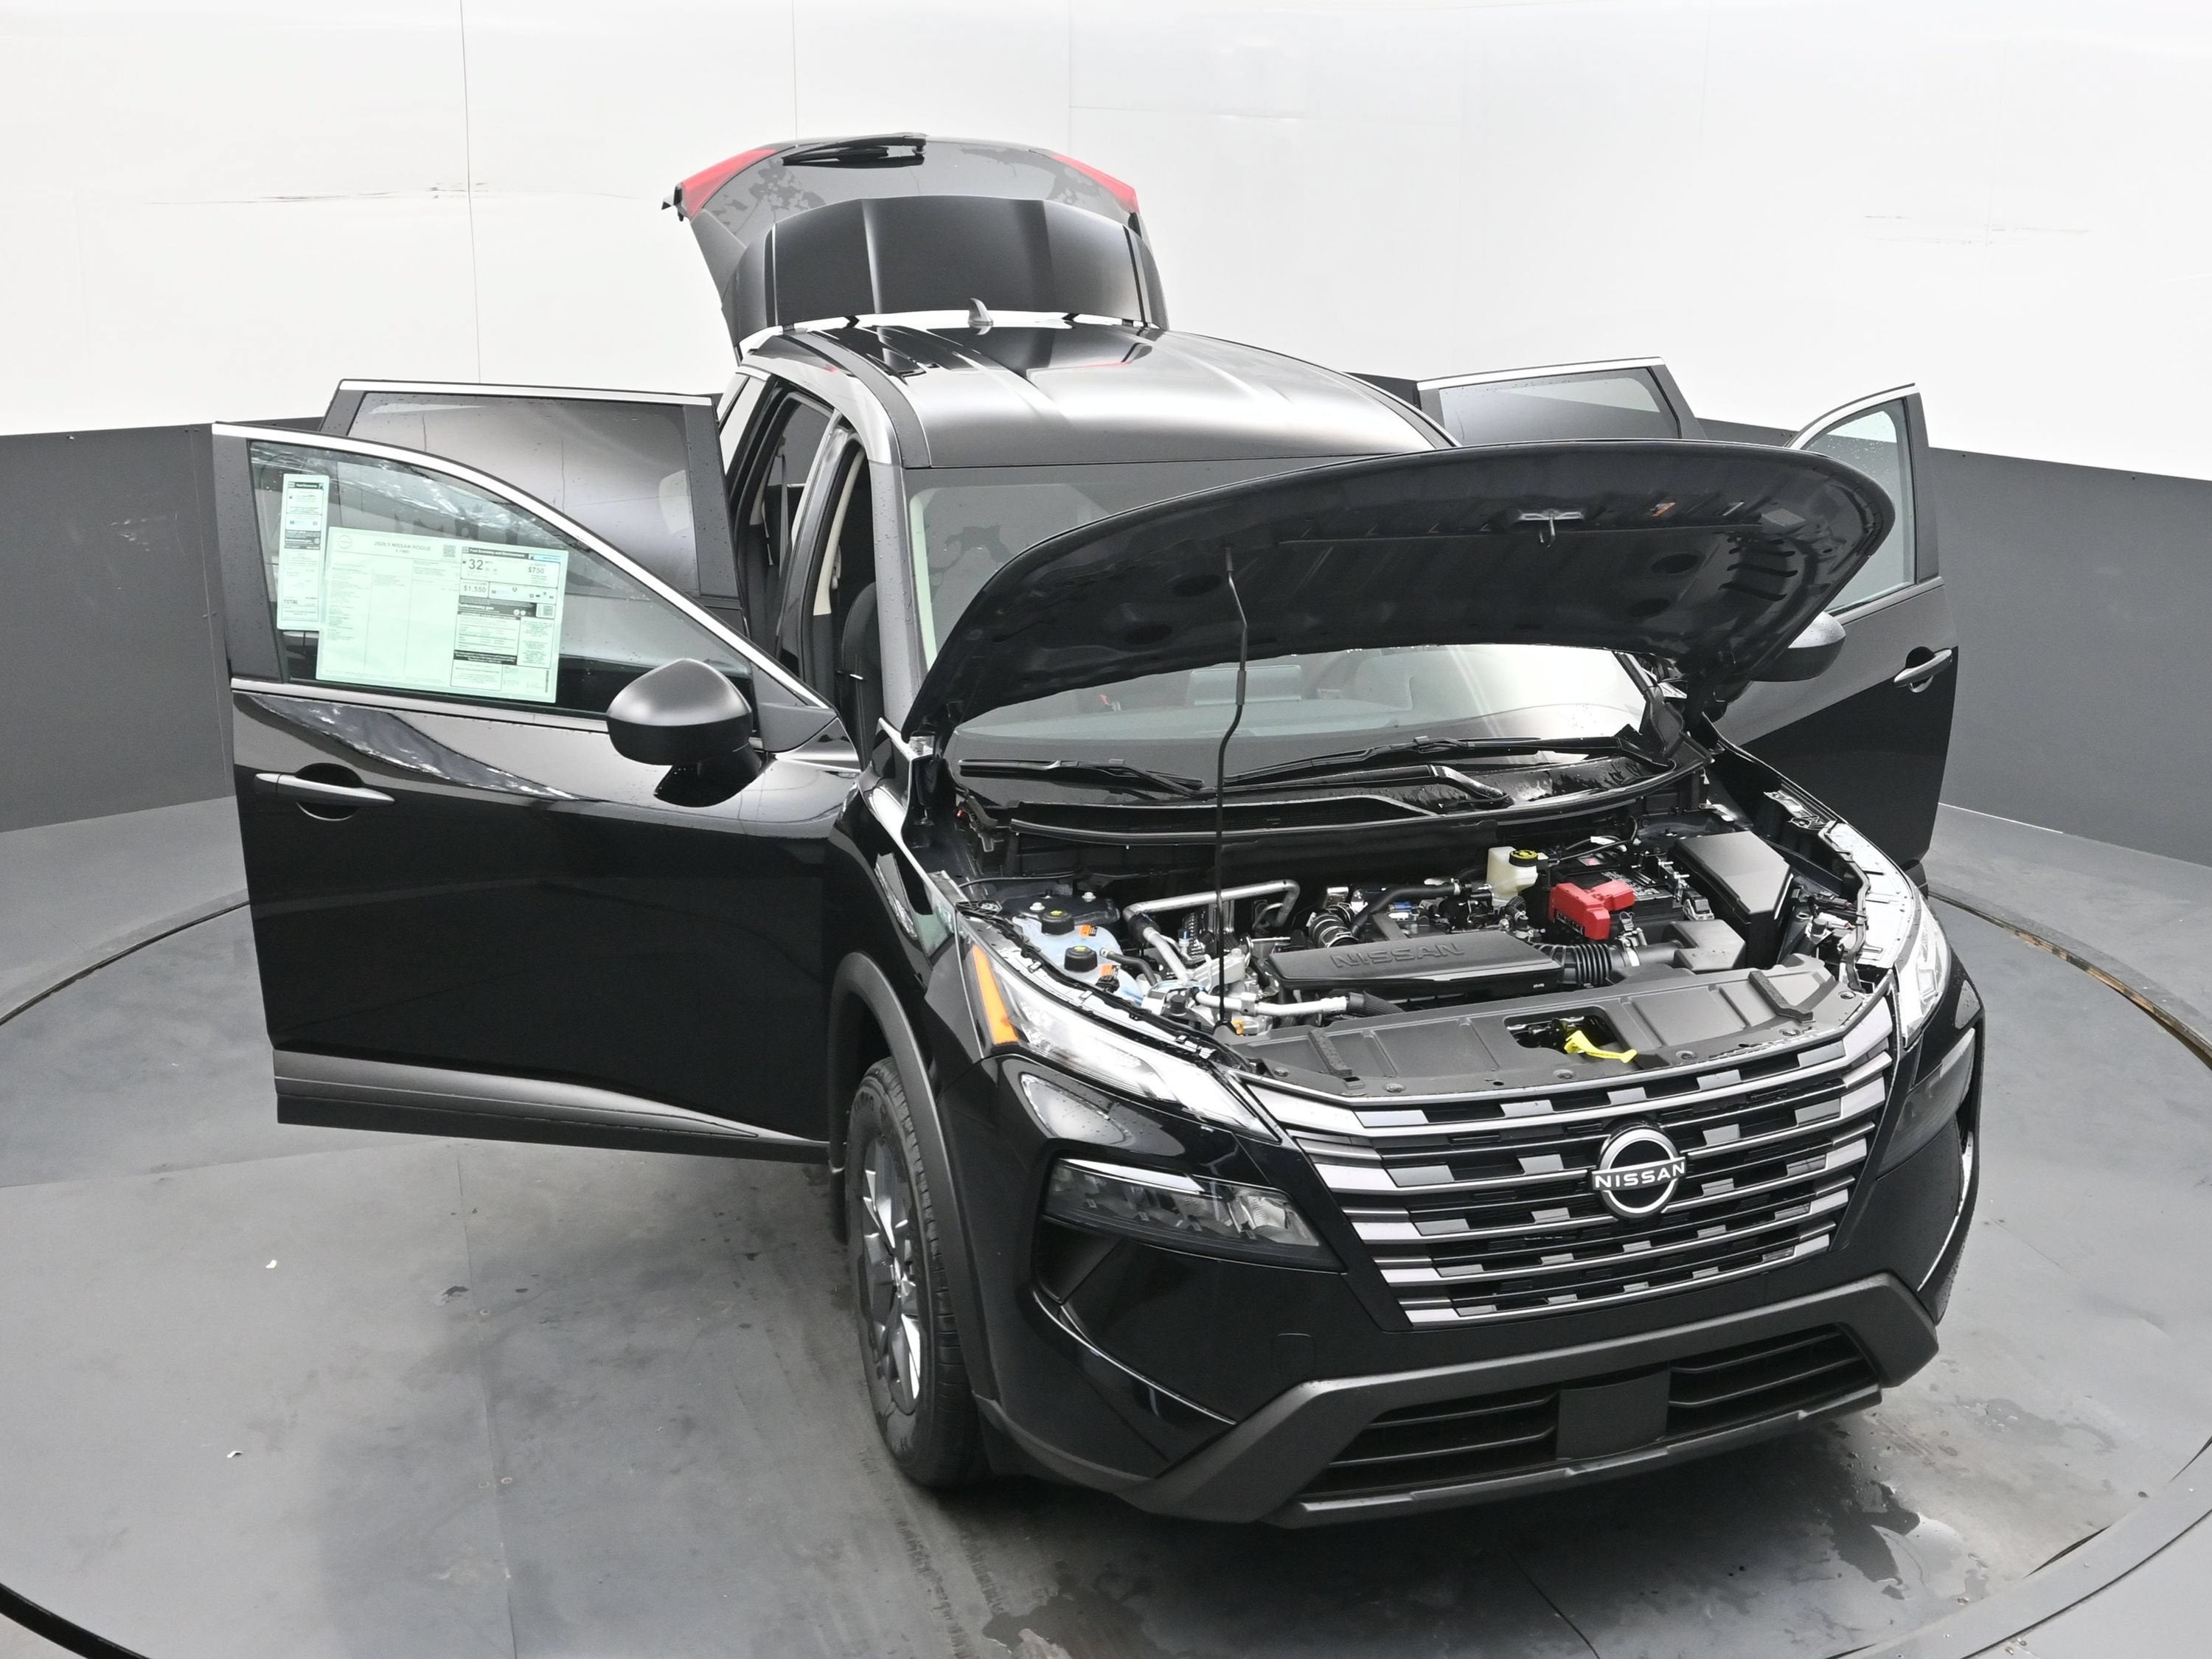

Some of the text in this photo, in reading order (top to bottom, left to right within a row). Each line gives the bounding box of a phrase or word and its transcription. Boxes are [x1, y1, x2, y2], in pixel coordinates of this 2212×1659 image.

[468, 558, 484, 571] 32
[528, 566, 545, 574] $750
[1330, 942, 1465, 968] NISSAN
[1595, 1161, 1686, 1189] NISSAN
